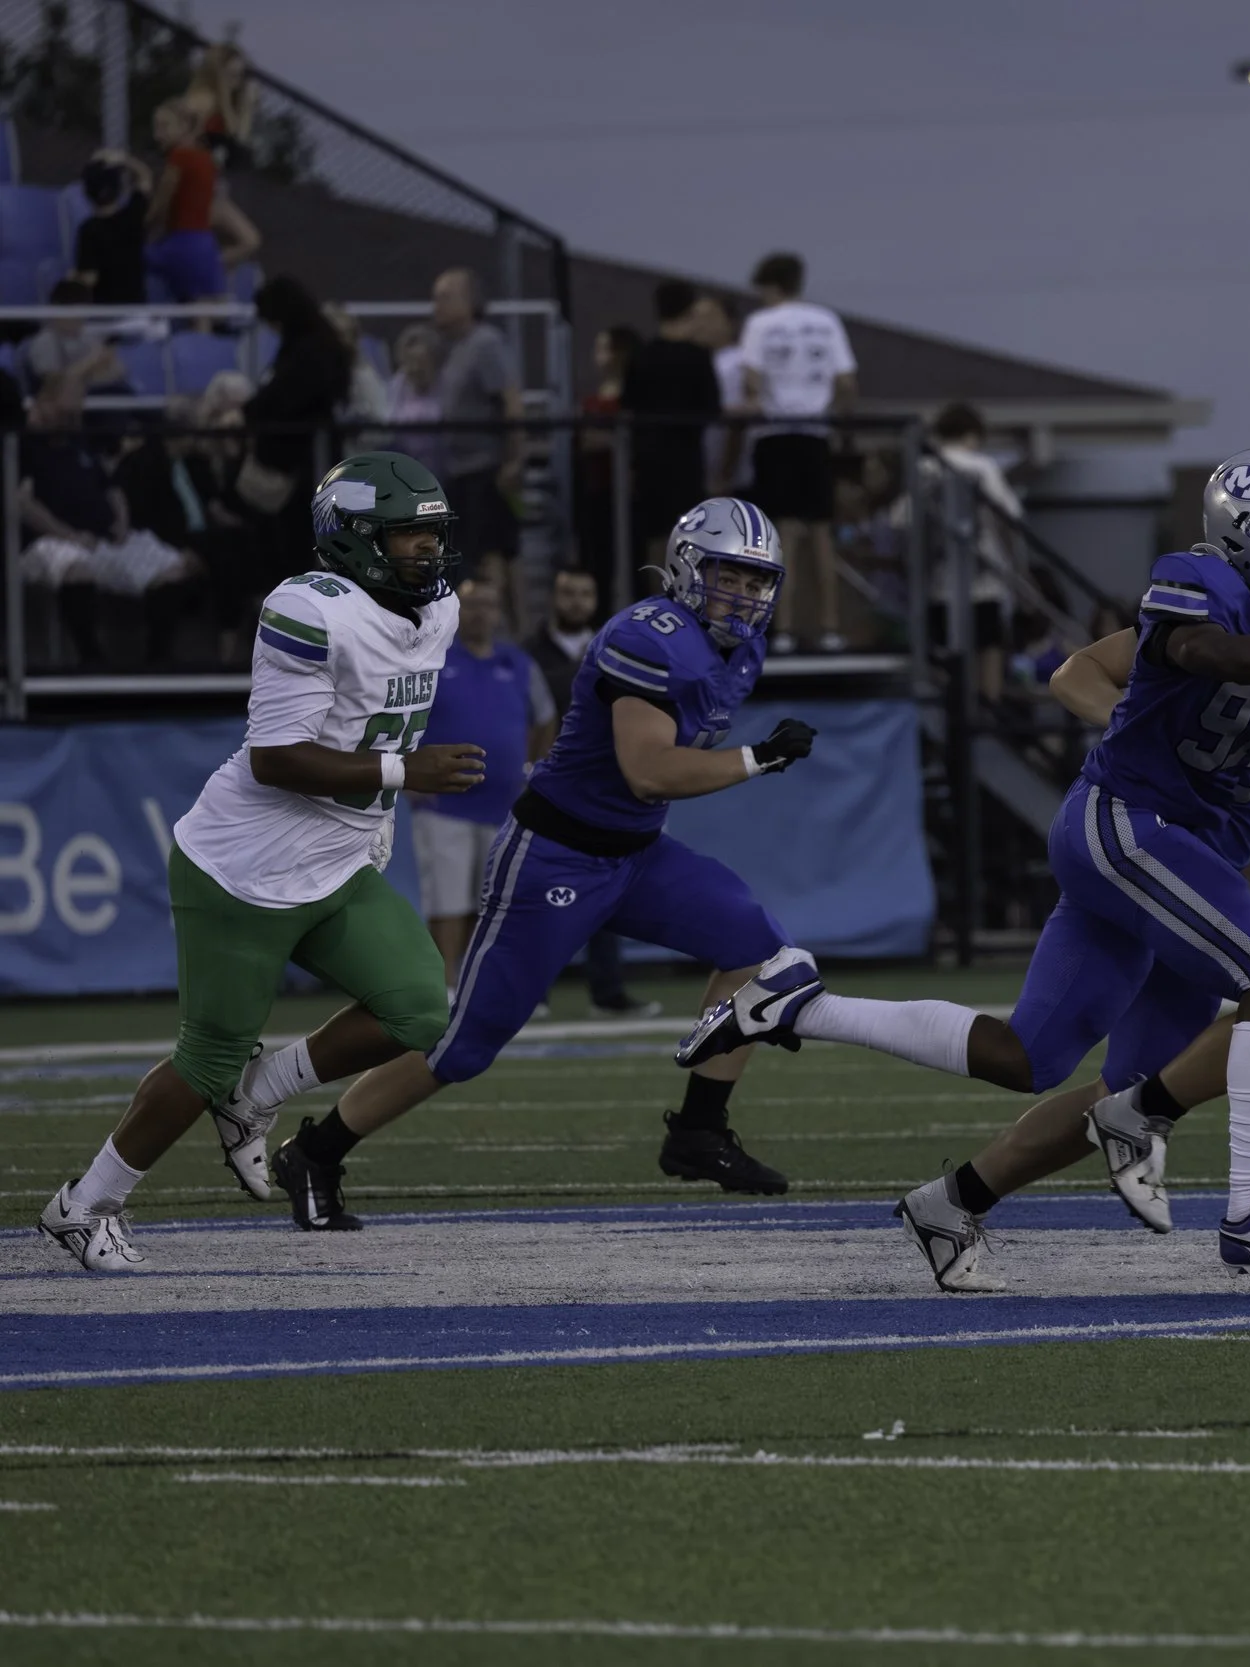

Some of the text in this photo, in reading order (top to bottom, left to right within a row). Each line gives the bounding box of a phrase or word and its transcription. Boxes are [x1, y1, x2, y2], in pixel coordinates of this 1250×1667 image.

[421, 502, 445, 512] Riddell
[631, 606, 686, 635] 45
[384, 672, 434, 709] EAGLES
